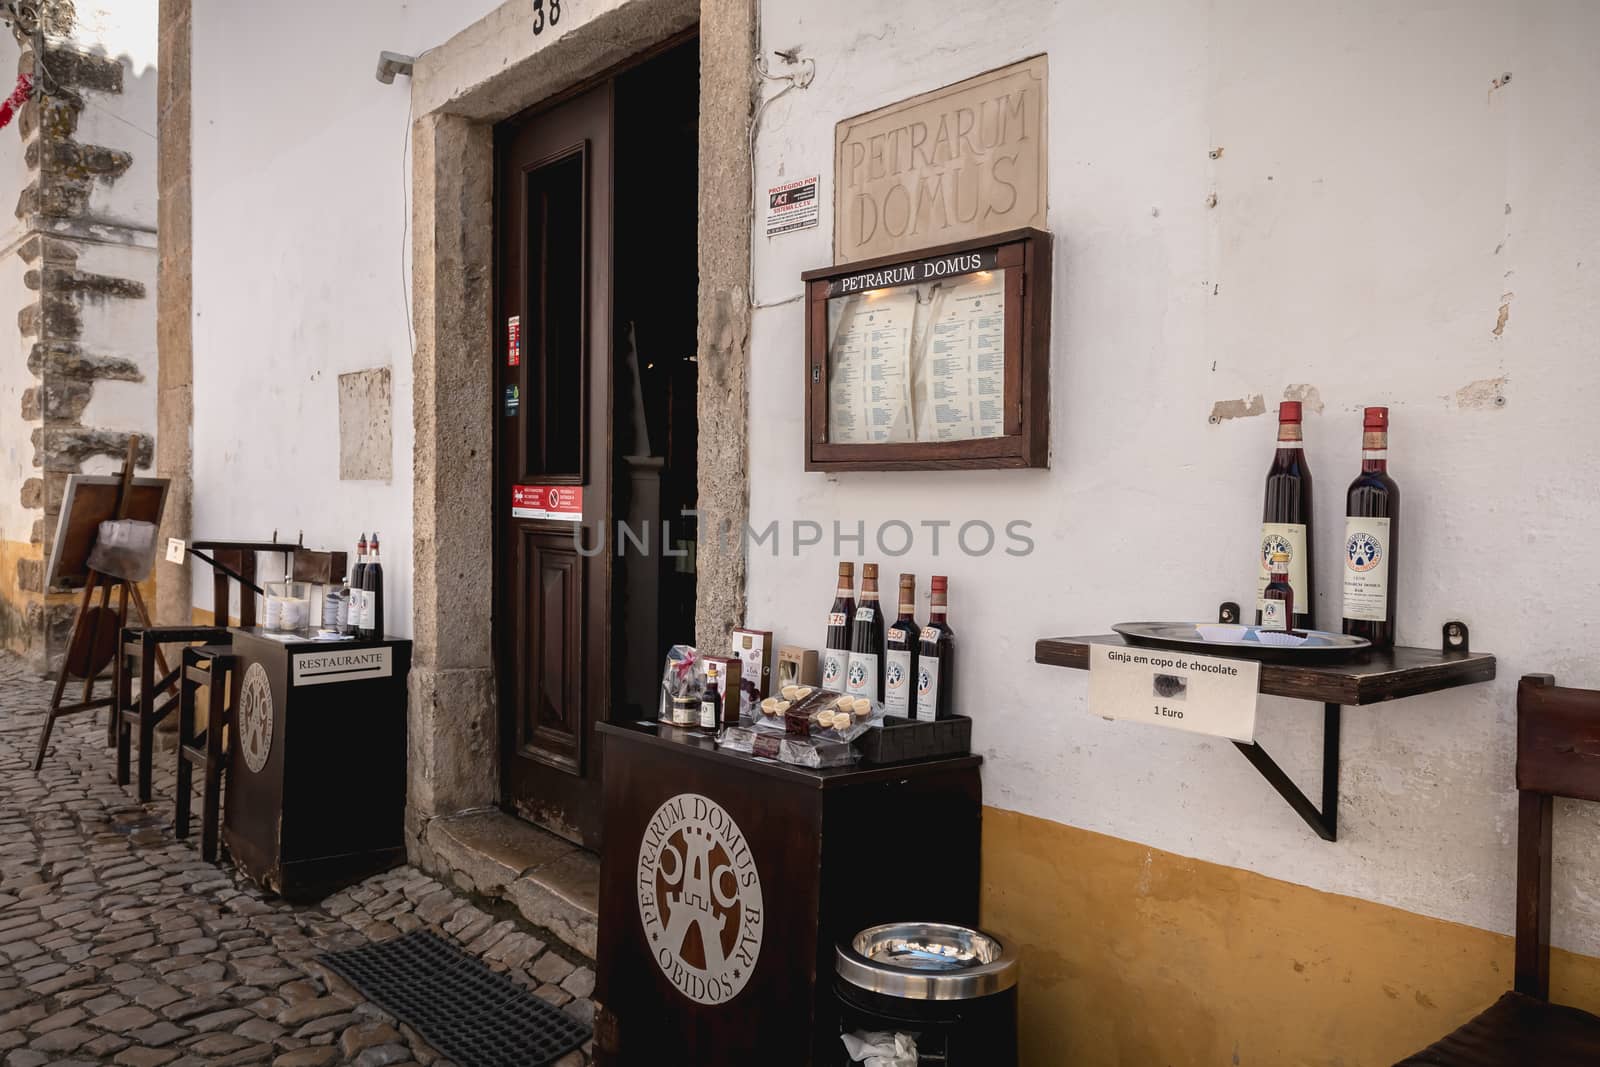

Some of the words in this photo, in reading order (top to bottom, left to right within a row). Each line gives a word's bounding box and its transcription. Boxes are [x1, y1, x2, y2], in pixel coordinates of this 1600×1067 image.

[533, 0, 561, 36] 38
[847, 88, 1028, 189] PETRARUM
[855, 152, 1020, 248] DOMUS
[841, 265, 915, 292] PETRARUM
[924, 254, 982, 278] DOMUS
[299, 653, 383, 670] RESTAURANTE
[1108, 651, 1131, 664] Ginja
[1134, 655, 1148, 665] em
[1150, 658, 1173, 669] copo
[1176, 659, 1188, 670] de
[1190, 661, 1238, 676] chocolate
[1154, 705, 1160, 715] 1
[1162, 707, 1184, 719] Euro
[639, 798, 687, 927] PETRARUM
[693, 797, 757, 888] DOMUS
[735, 903, 761, 968] BAR
[658, 947, 733, 1001] OBIDOS
